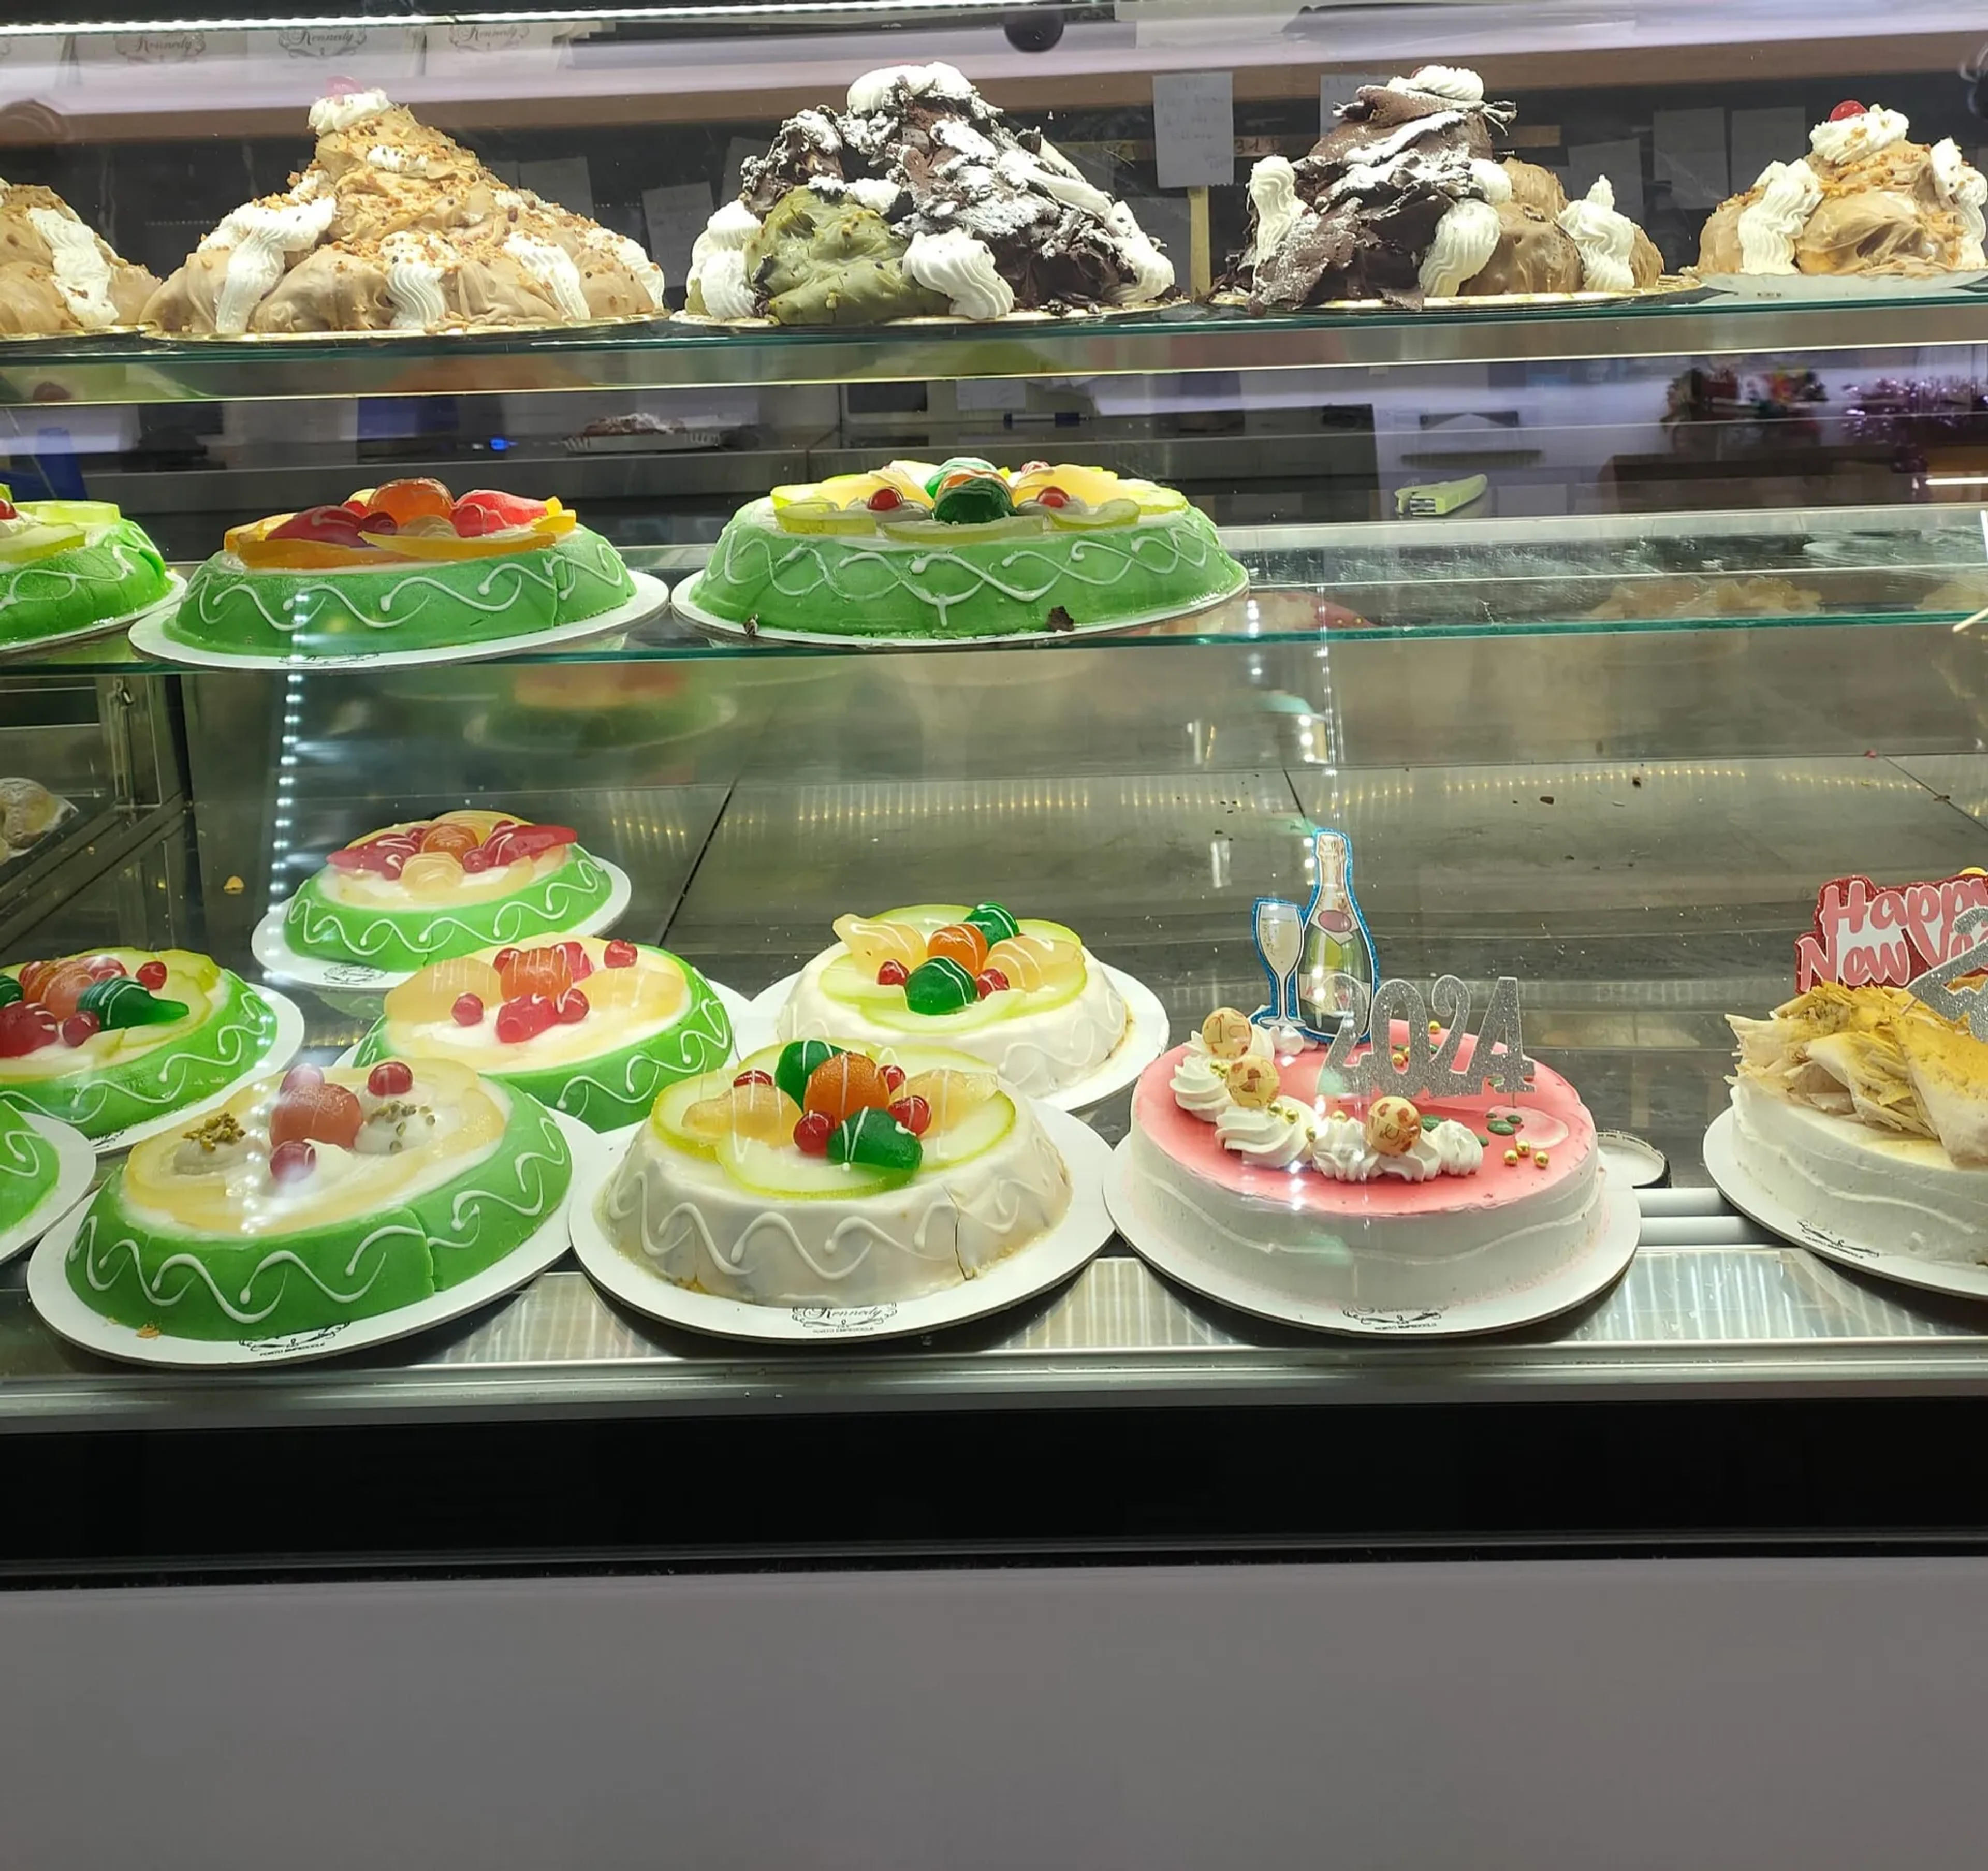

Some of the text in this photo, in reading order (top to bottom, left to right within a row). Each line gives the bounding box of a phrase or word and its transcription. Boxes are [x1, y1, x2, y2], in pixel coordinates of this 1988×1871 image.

[1797, 936, 1911, 993] New
[1315, 973, 1536, 1098] 2024
[803, 1307, 882, 1321] Kennedy
